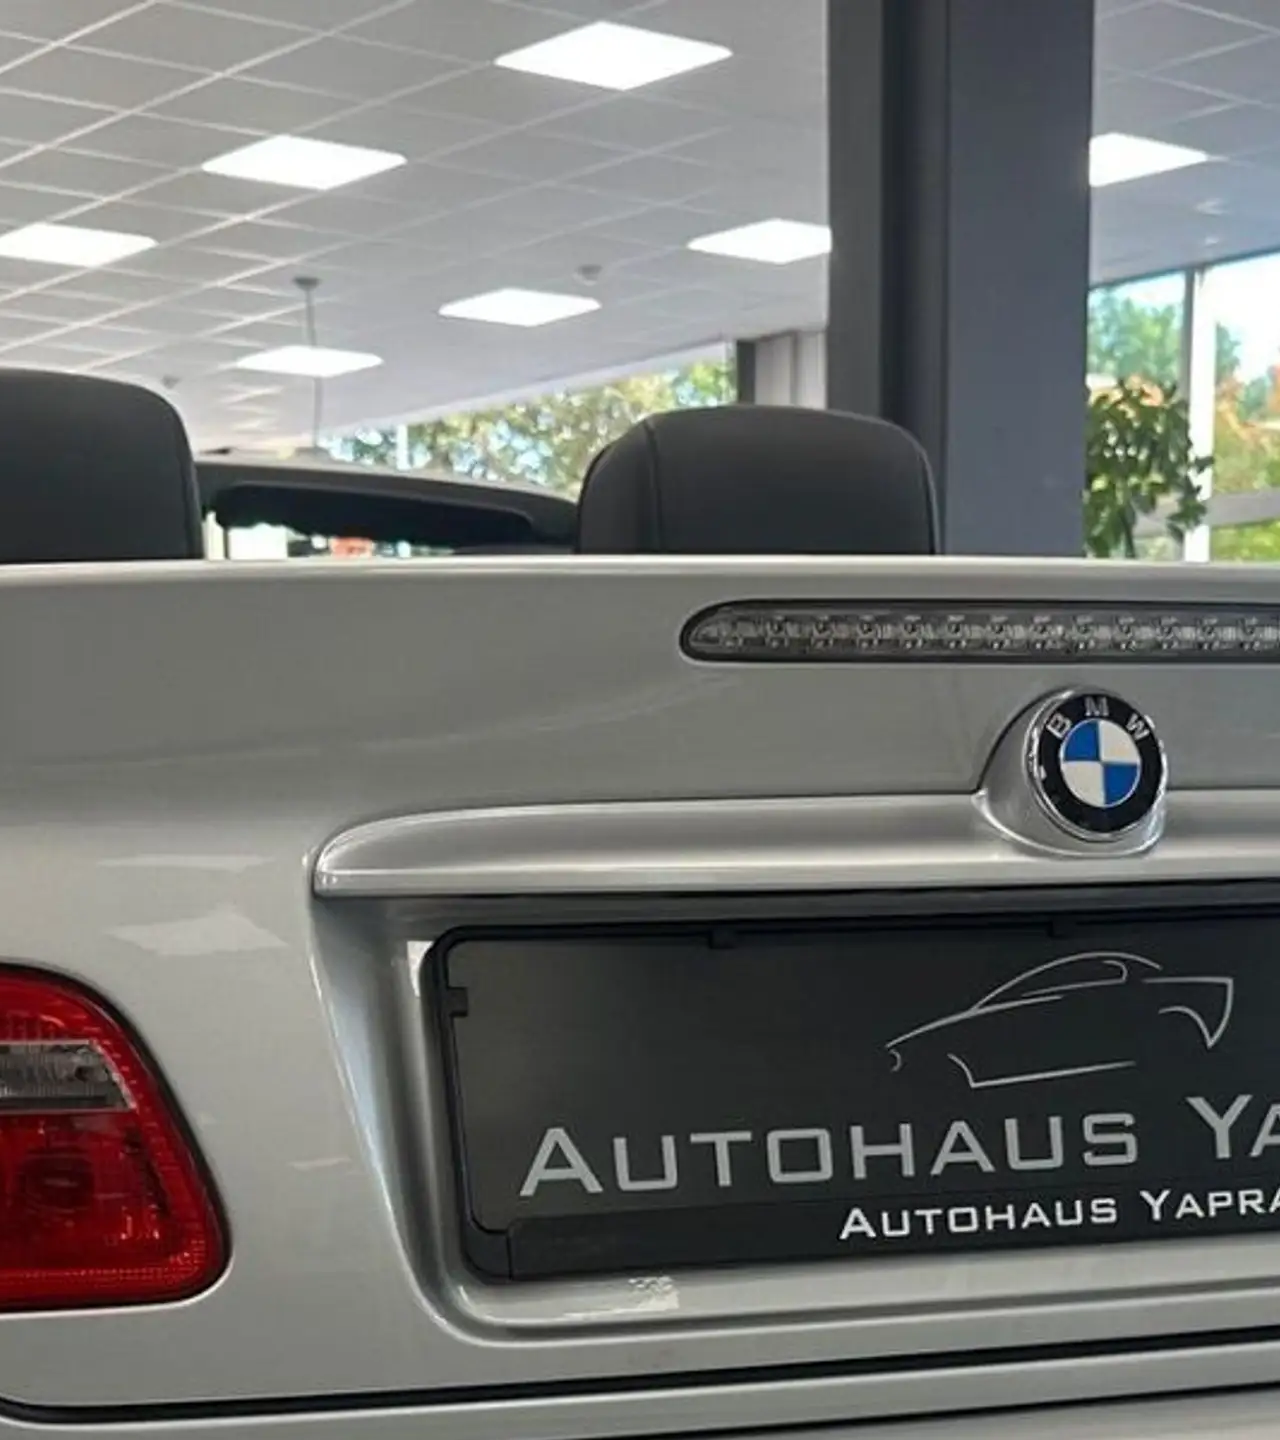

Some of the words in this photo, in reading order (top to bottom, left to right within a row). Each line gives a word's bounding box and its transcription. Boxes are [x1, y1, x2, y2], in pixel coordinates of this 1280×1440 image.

[1045, 695, 1151, 740] BMW
[520, 1113, 1138, 1197] AUTOHAUS
[839, 1197, 1118, 1240] AUTOHAUS
